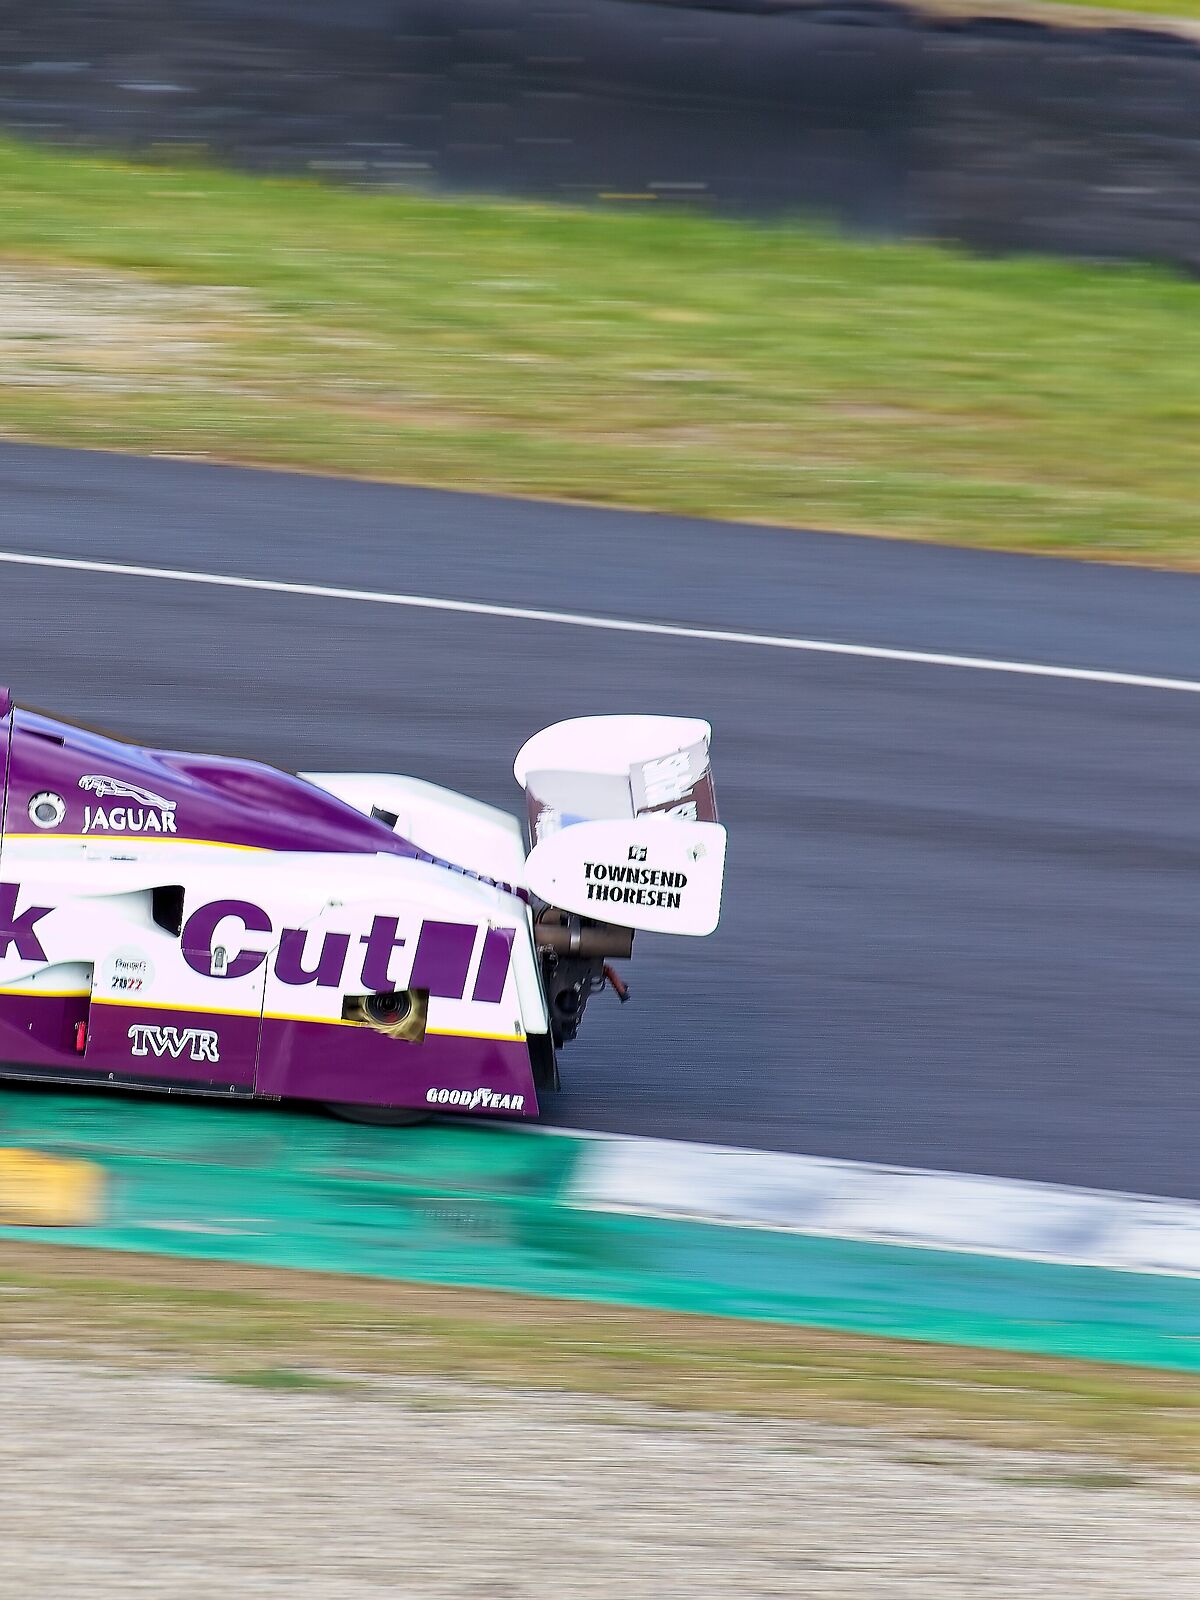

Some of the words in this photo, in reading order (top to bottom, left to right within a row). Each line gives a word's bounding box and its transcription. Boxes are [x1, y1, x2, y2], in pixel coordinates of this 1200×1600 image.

[81, 805, 178, 834] JAGUAR
[583, 862, 688, 889] TOWNSEND
[586, 883, 682, 909] THORESEN
[180, 899, 406, 992] Cut
[111, 976, 143, 991] 2022
[127, 1024, 220, 1063] TWR
[426, 1088, 524, 1110] GOODYEAR
